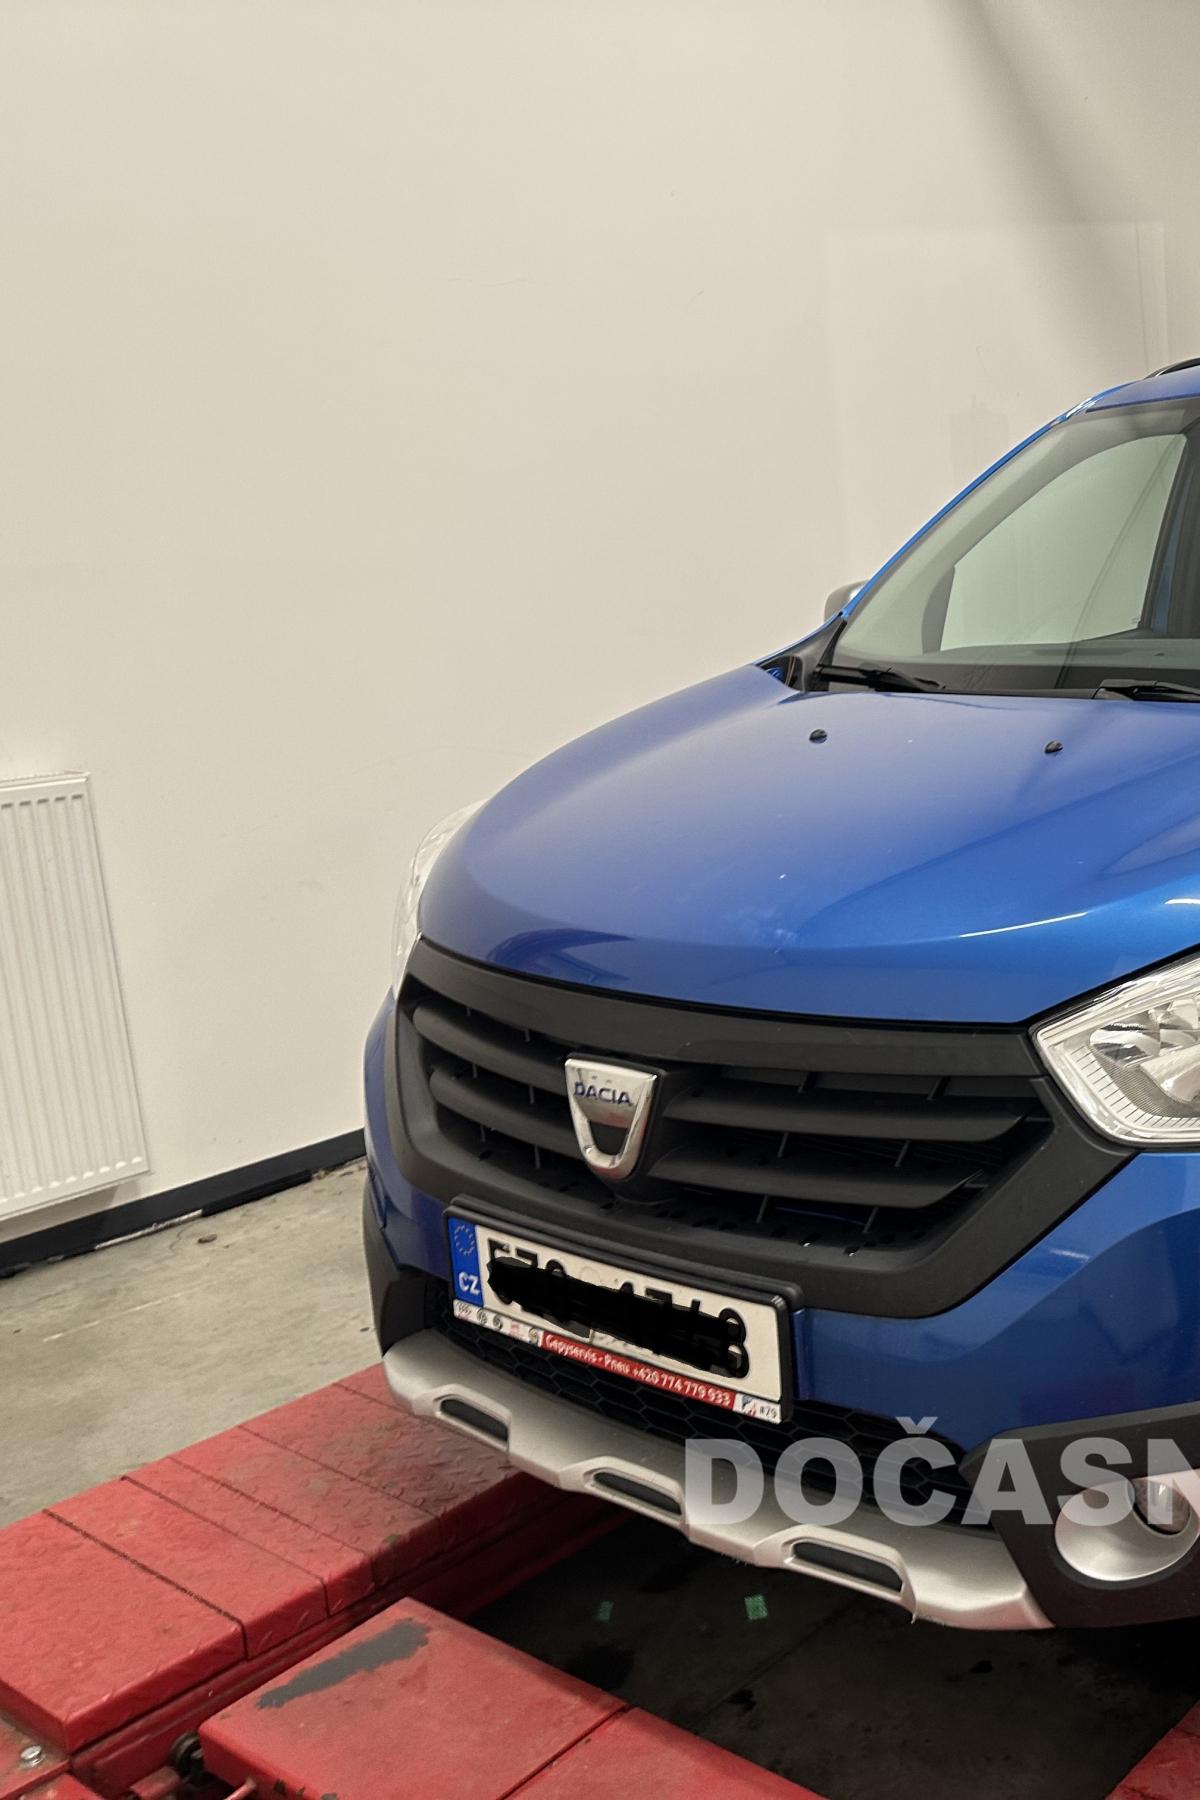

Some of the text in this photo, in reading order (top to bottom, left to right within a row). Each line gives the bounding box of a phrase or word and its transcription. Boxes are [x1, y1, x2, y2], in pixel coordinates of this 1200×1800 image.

[574, 1081, 634, 1107] DACIA
[458, 1271, 480, 1295] CZ
[633, 1367, 660, 1385] +420
